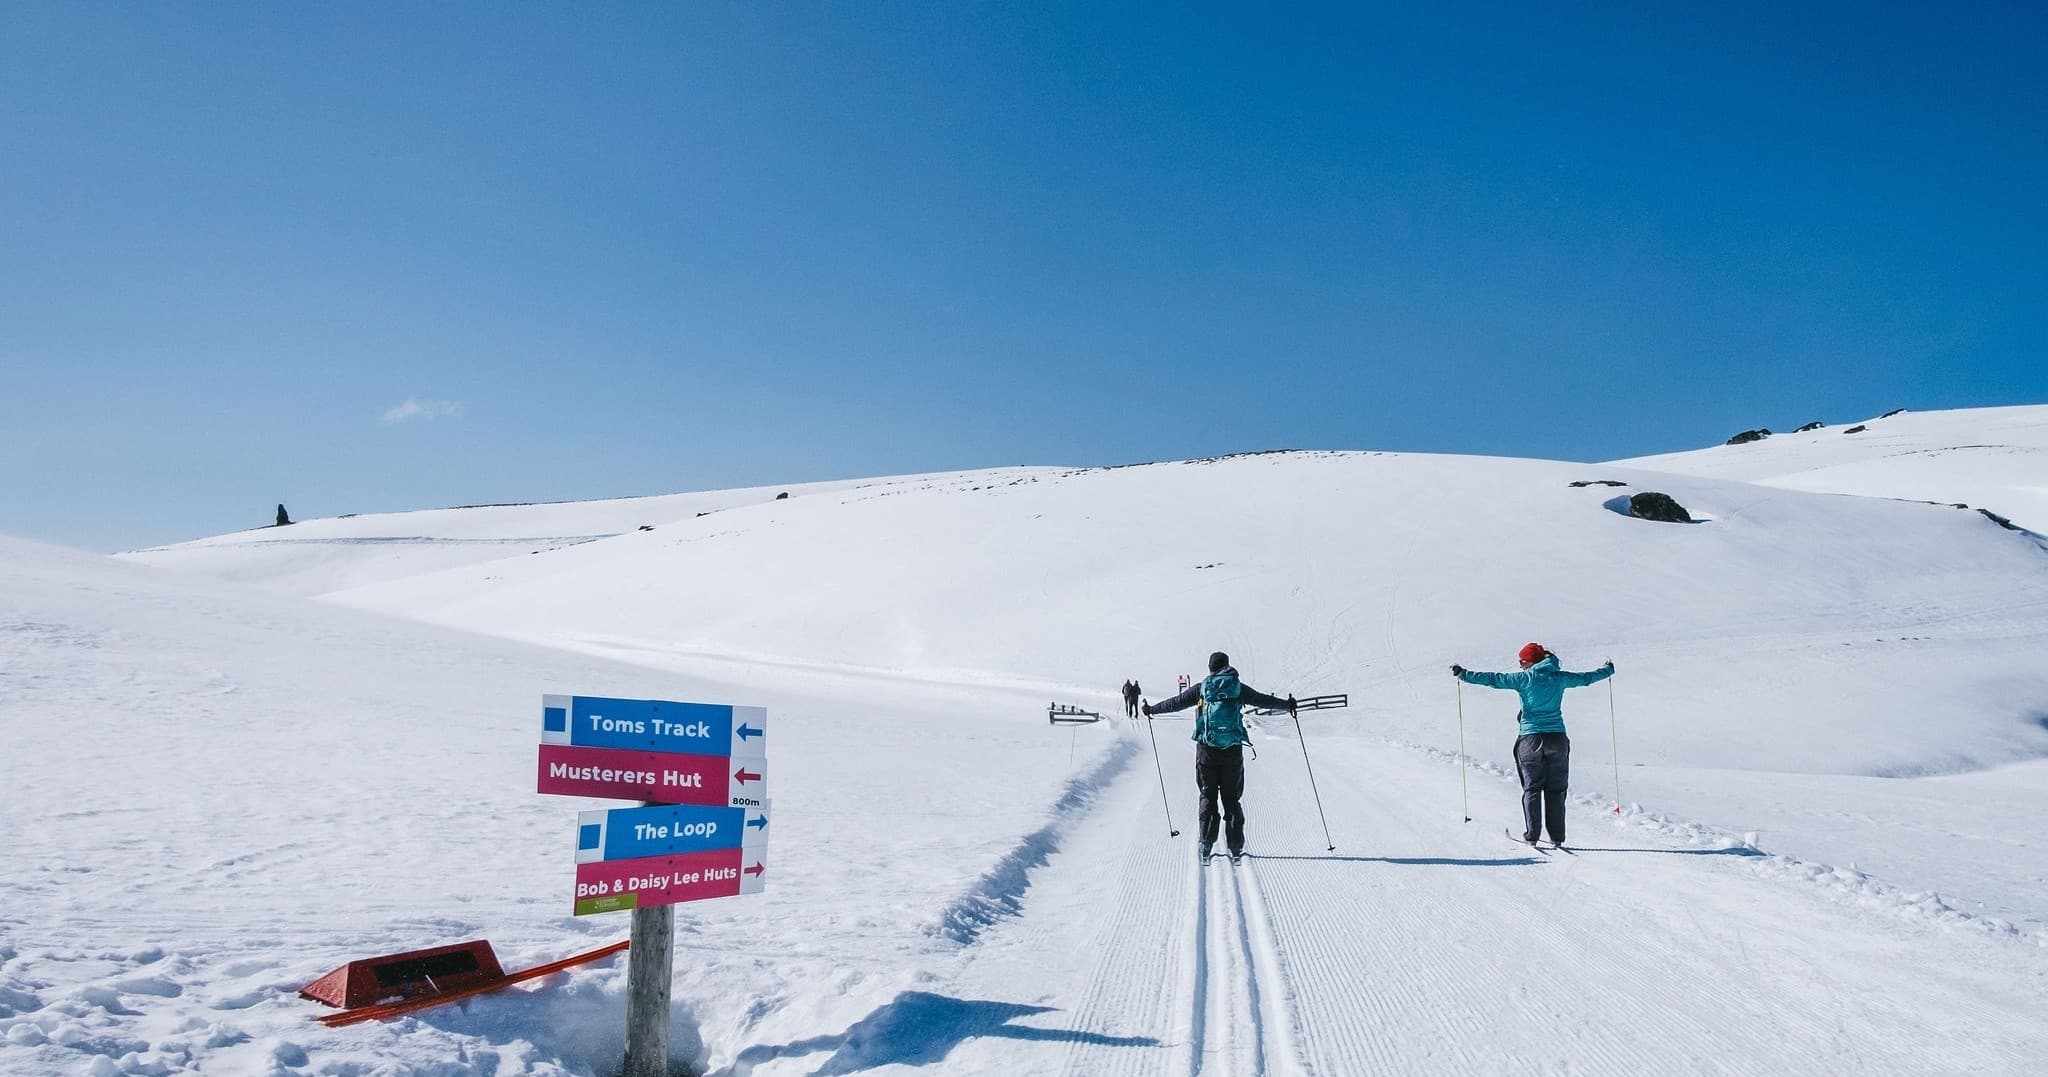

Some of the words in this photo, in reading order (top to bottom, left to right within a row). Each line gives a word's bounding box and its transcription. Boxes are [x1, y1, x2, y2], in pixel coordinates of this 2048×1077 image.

[589, 715, 645, 734] Toms
[652, 719, 711, 738] Track
[550, 762, 656, 785] Musterers
[663, 770, 702, 788] Hut
[732, 797, 760, 807] 800m
[635, 824, 668, 841] The
[674, 820, 717, 839] Loop
[577, 879, 608, 897] Bob
[613, 878, 624, 893] &
[628, 873, 670, 892] Daisy
[674, 870, 699, 886] Lee
[704, 866, 737, 881] Huts
